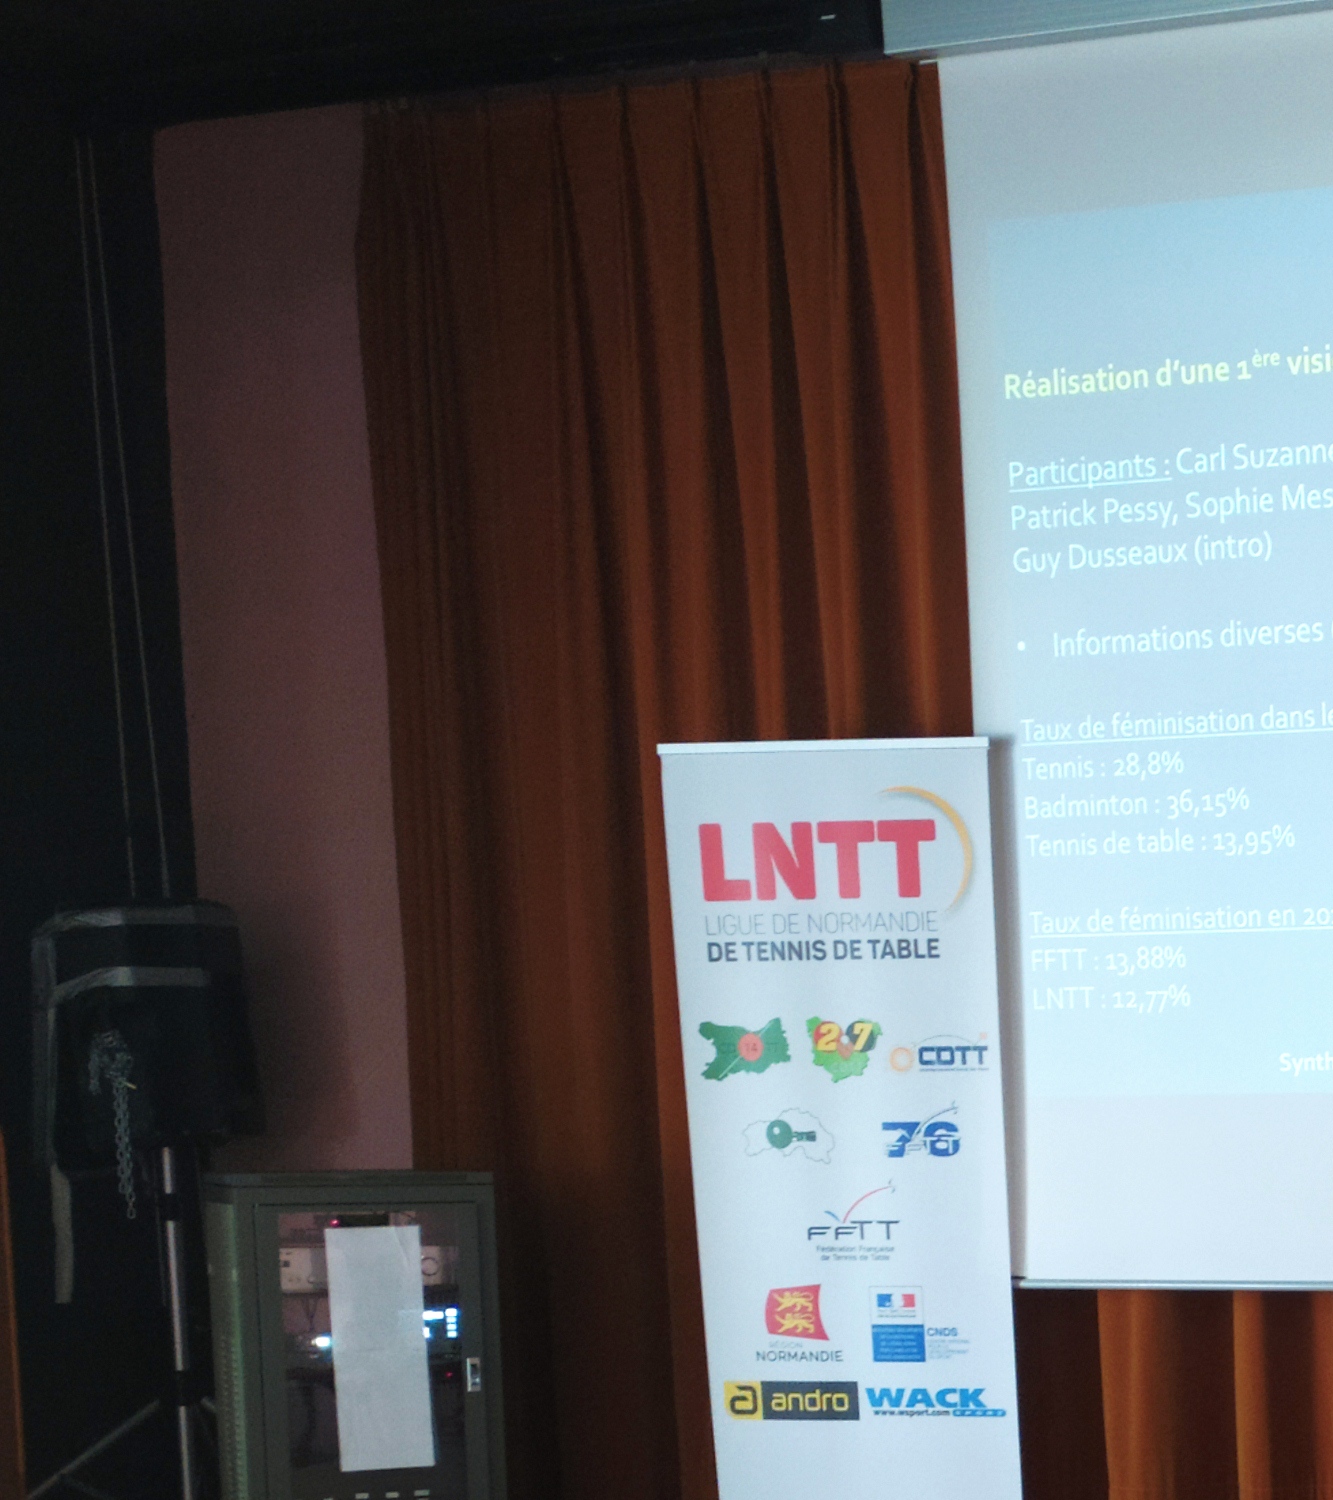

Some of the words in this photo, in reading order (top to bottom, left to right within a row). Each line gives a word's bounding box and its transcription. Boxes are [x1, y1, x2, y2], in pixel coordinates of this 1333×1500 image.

[1005, 363, 1148, 399] Réalisation
[1238, 352, 1280, 380] 1ère
[1009, 454, 1155, 491] Participants
[1177, 444, 1225, 473] Carl
[1012, 499, 1095, 529] Patrick
[1104, 498, 1177, 528] Pessy,
[1186, 488, 1273, 523] Sophie
[1013, 546, 1061, 579] Guy
[1069, 541, 1187, 570] Dusseaux
[1195, 529, 1272, 565] (intro)
[1054, 625, 1212, 657] Informations
[1221, 620, 1323, 647] diverses
[1021, 718, 1070, 745] Taux
[1079, 715, 1104, 744] de
[1112, 712, 1253, 742] féminisation
[1261, 704, 1315, 729] dans
[1023, 757, 1093, 781] Tennis
[1114, 751, 1184, 782] 28,8%
[1025, 793, 1147, 819] Badminton
[1167, 786, 1250, 820] 36,15%
[1026, 834, 1097, 857] Tennis
[1103, 831, 1130, 854] de
[1137, 828, 1194, 854] table
[1213, 823, 1295, 857] 13,95%
[698, 819, 936, 901] LNTT
[705, 913, 764, 936] LIGUE
[772, 913, 799, 934] DE
[807, 911, 938, 934] NORMANDIE
[1030, 911, 1079, 939] Taux
[1087, 909, 1113, 938] de
[1120, 905, 1261, 937] féminisation
[1268, 908, 1295, 932] en
[707, 942, 737, 962] DE
[742, 940, 827, 962] TENNIS
[833, 940, 863, 960] DE
[867, 938, 941, 960] TABLE
[1031, 947, 1087, 970] FFTT
[1106, 945, 1186, 977] 13,88%
[1034, 985, 1094, 1010] LNTT
[1113, 983, 1191, 1014] 12,77%
[807, 1220, 900, 1240] FFTT
[927, 1327, 958, 1337] CNDS
[756, 1351, 844, 1362] NORMANDIE
[770, 1389, 849, 1412] andro
[865, 1388, 987, 1408] WACK
